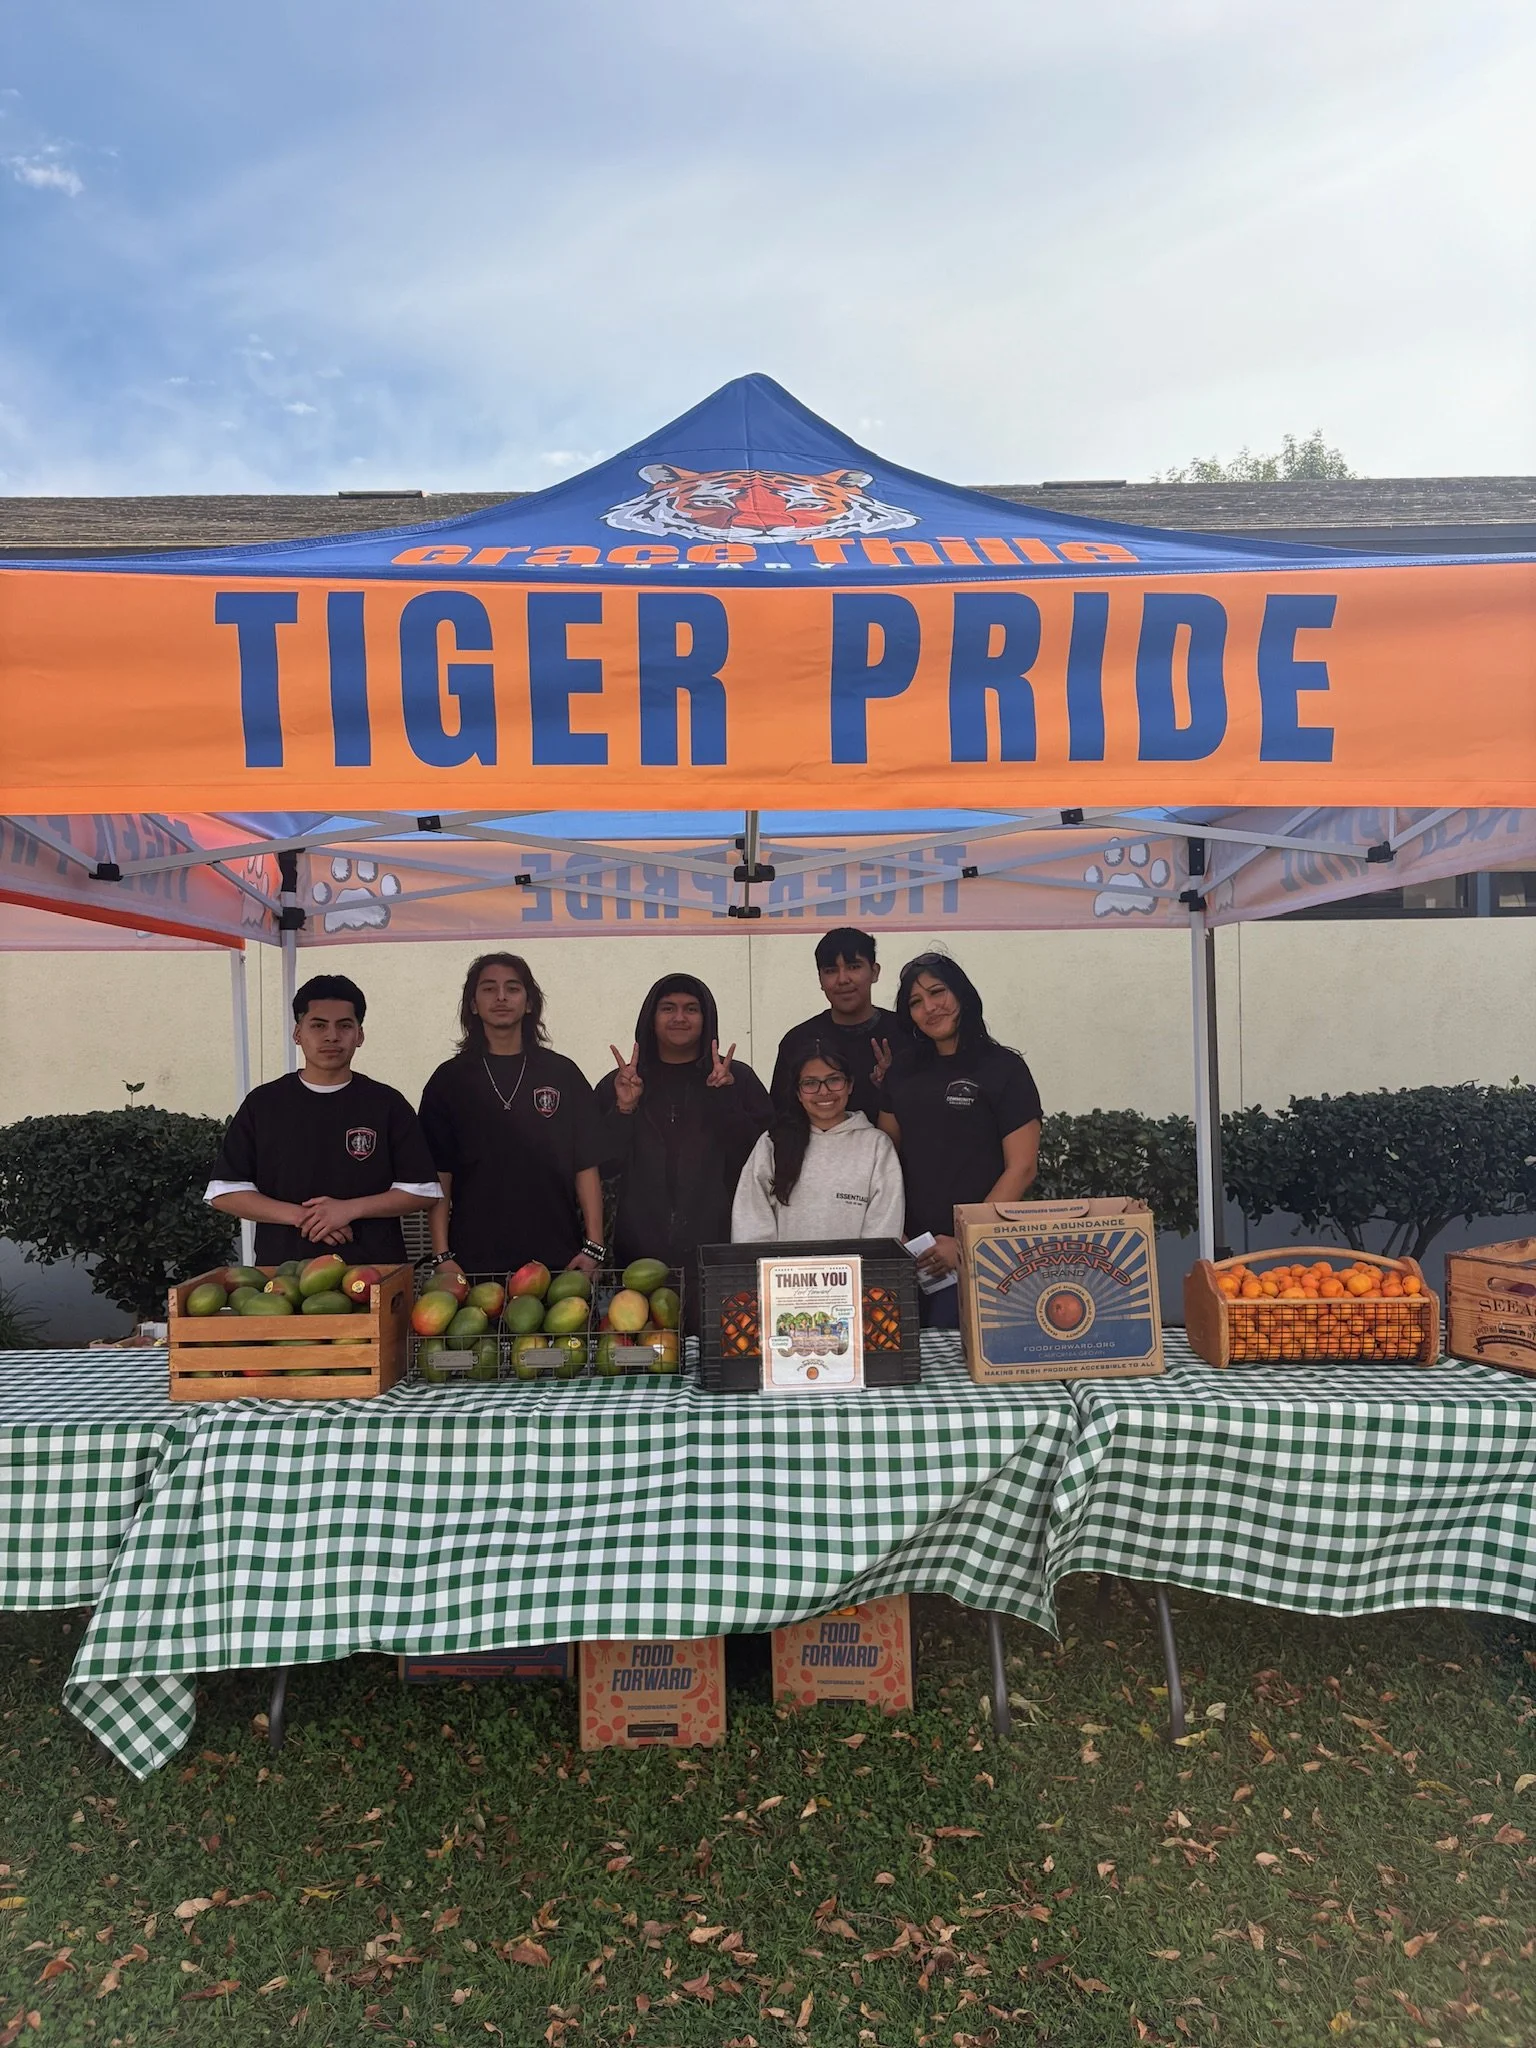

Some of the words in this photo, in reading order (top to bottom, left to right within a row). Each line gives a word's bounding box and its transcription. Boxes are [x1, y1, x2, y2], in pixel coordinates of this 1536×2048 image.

[390, 544, 757, 566] Grace
[796, 536, 1140, 565] Thille
[214, 590, 731, 769] TIGER
[830, 591, 1338, 765] PRIDE
[993, 1223, 1048, 1234] SHARING
[1052, 1218, 1126, 1230] ABUNDANCE
[1016, 1240, 1112, 1264] FOOD
[775, 1272, 818, 1288] THANK
[821, 1272, 847, 1287] YOU
[996, 1252, 1133, 1295] FORWARD
[1042, 1268, 1086, 1279] BRAND
[1479, 1297, 1536, 1317] SEEA
[1023, 1341, 1116, 1352] FOODFORWARD.ORG
[984, 1369, 1014, 1377] MAKING
[1080, 1363, 1127, 1371] ACCESSIBLE
[820, 1622, 860, 1644] FOOD
[631, 1644, 674, 1667] FOOD
[801, 1645, 879, 1667] FORWARD
[611, 1667, 693, 1692] FORWARD
